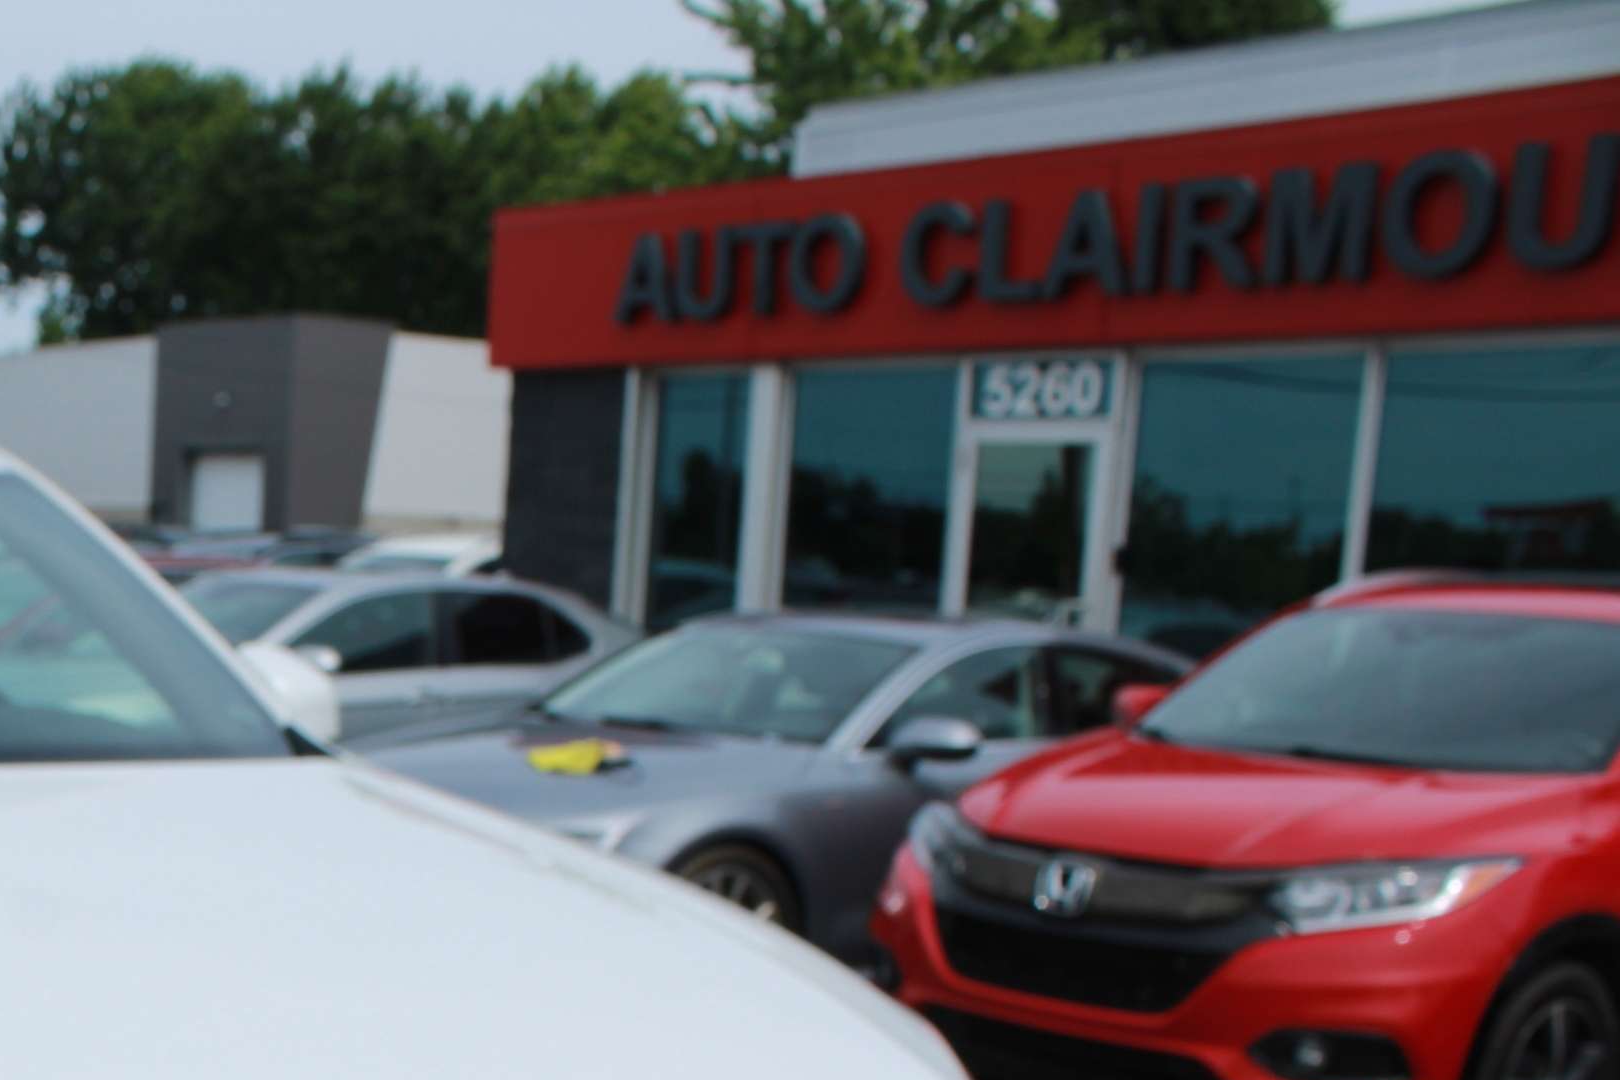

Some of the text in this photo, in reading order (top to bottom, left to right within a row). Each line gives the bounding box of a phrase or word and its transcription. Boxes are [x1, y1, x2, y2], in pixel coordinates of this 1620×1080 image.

[616, 132, 1620, 326] AUTO CLAIRMOU
[982, 360, 1104, 418] 5260
